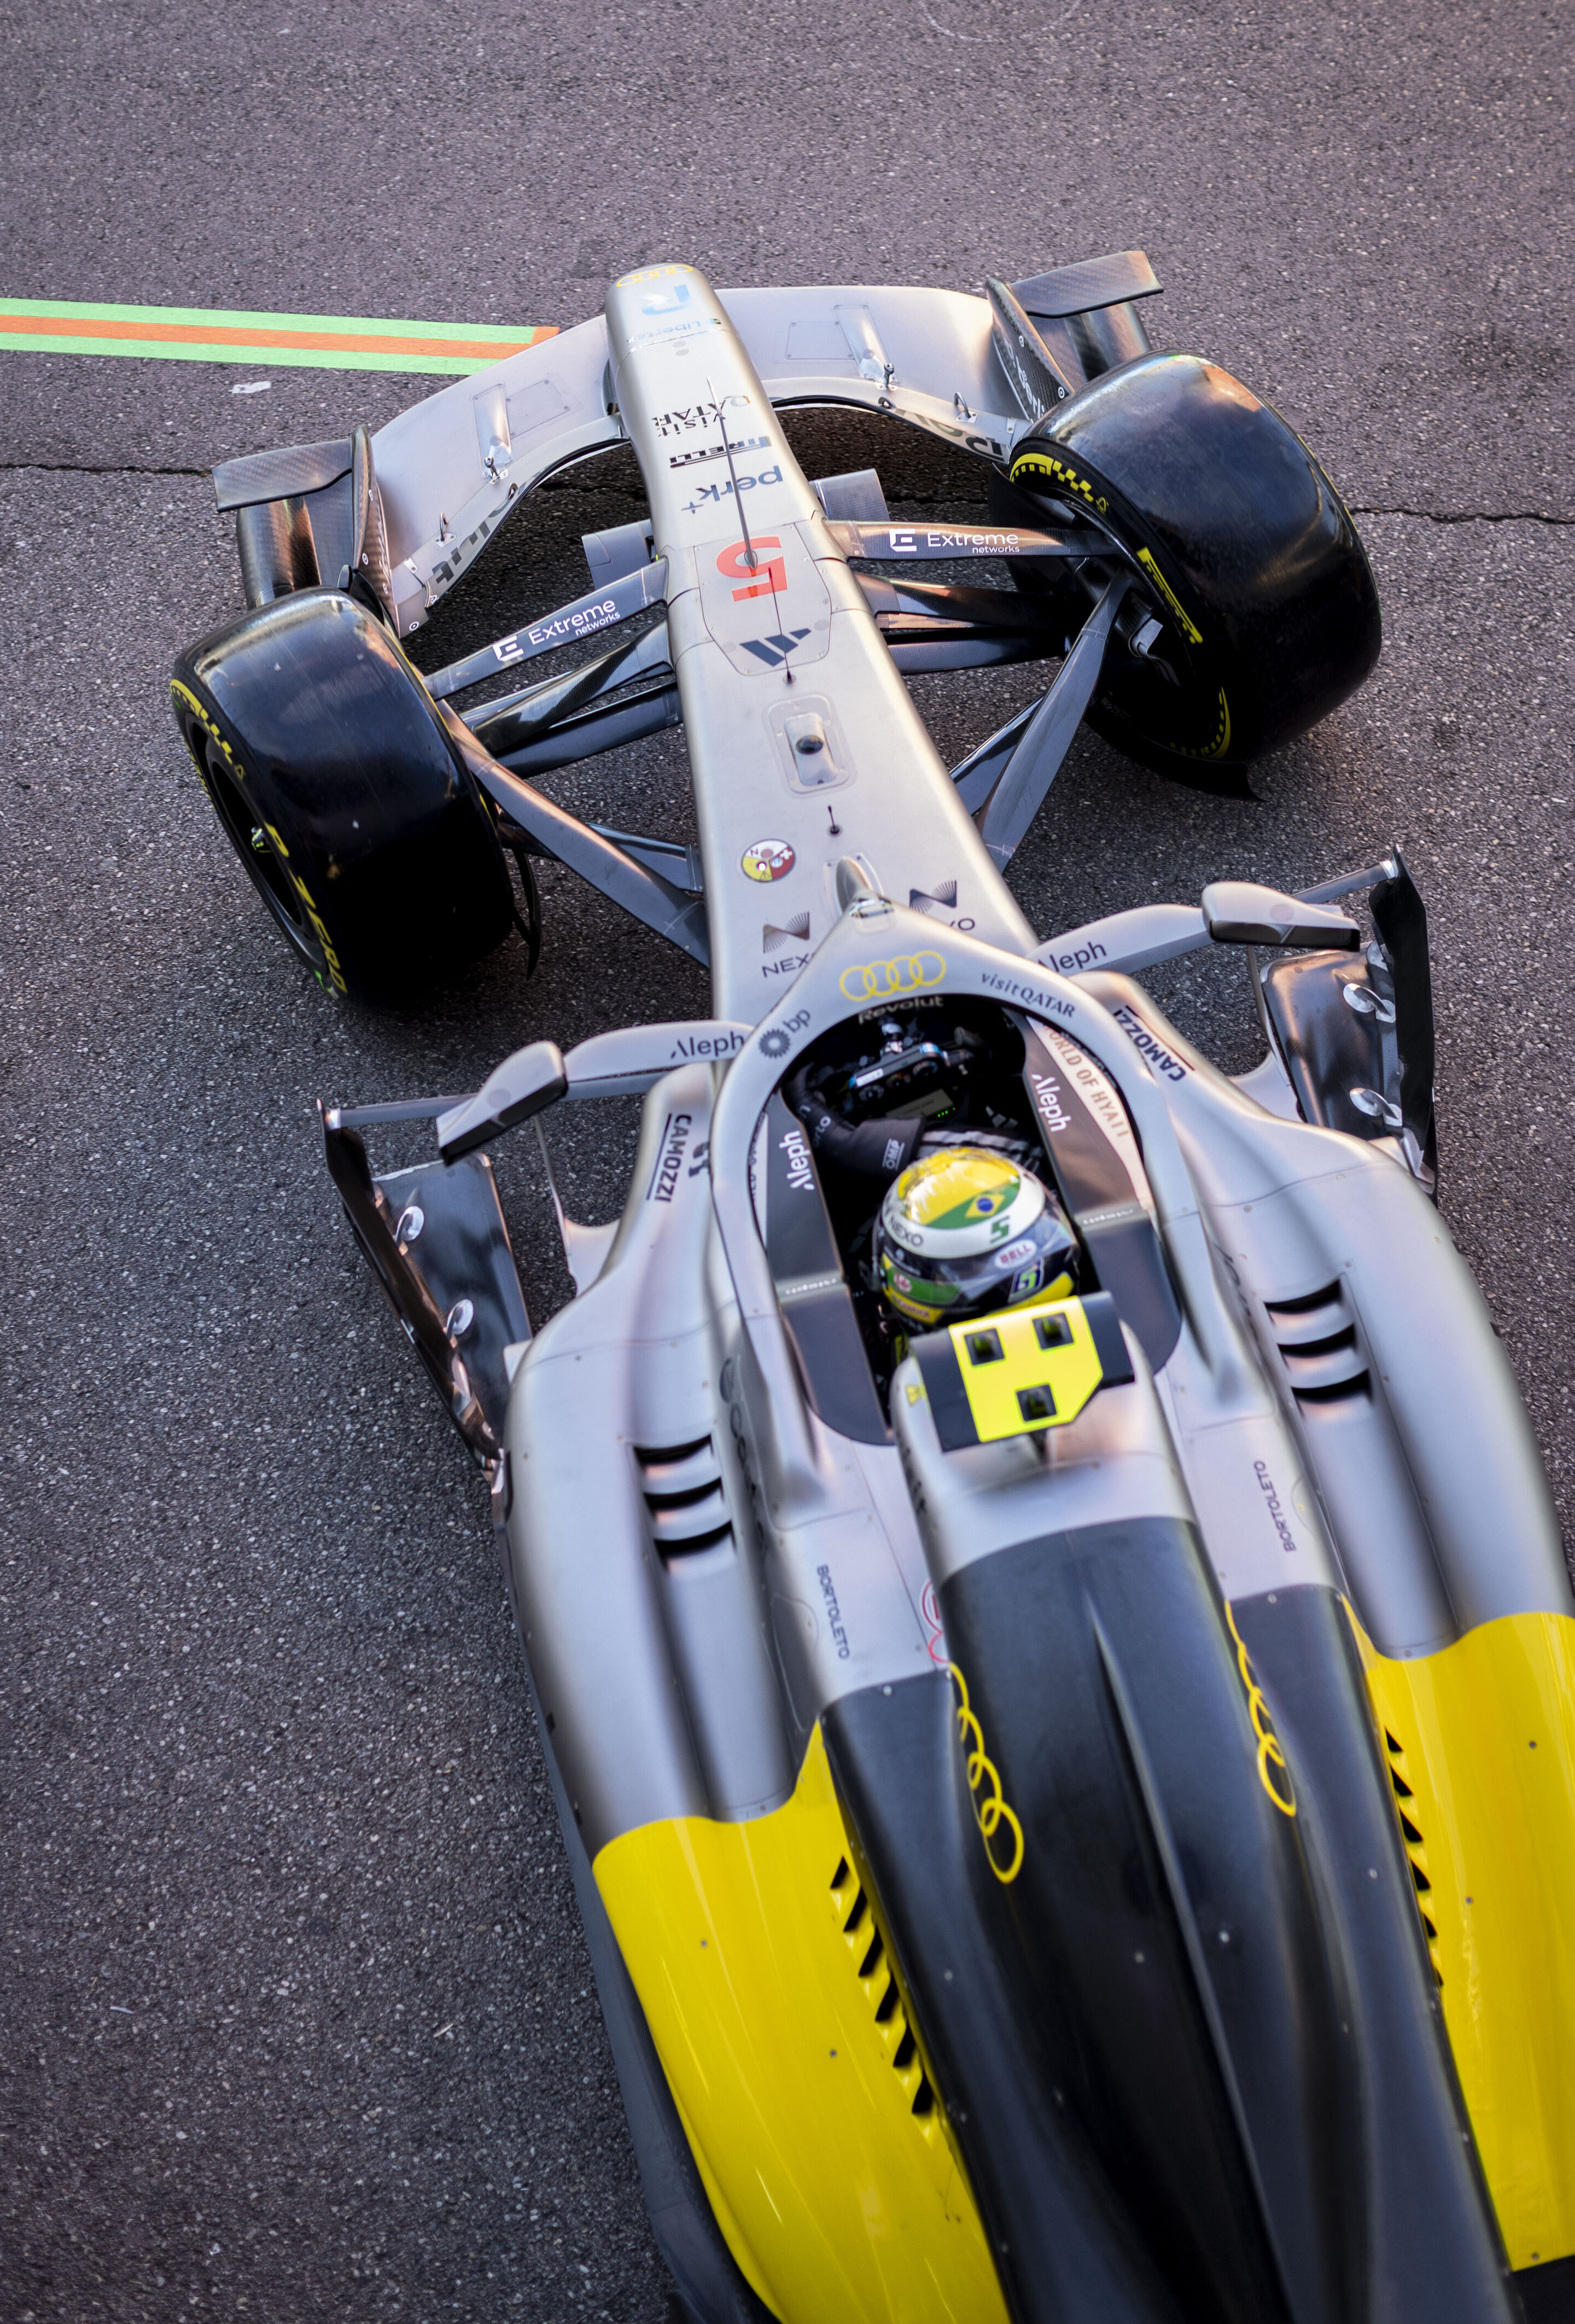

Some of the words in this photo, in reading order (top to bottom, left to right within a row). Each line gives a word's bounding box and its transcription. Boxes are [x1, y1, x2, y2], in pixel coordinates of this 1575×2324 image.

[652, 395, 751, 427] QATAR
[656, 413, 726, 437] visit
[670, 436, 772, 469] PIRELLI
[927, 532, 1019, 547] Extreme
[972, 545, 1020, 554] networks
[716, 536, 788, 602] 5
[528, 600, 616, 645] Extreme
[575, 611, 621, 637] networks
[762, 952, 815, 978] NEX
[783, 1009, 812, 1033] bp
[858, 996, 944, 1025] Revolut
[1043, 1024, 1082, 1066] ORLD
[1076, 1069, 1099, 1087] OF
[1114, 1009, 1187, 1081] CAMOZZI
[1031, 1074, 1072, 1132] Aleph
[654, 1113, 692, 1203] CAMOZZI
[779, 1130, 815, 1190] Aleph
[885, 1139, 901, 1170] OMP
[888, 1215, 924, 1248] NEXO
[989, 1215, 1011, 1245] 5
[999, 1244, 1032, 1264] BELL
[1253, 1460, 1296, 1552] BORTOLETO
[816, 1564, 850, 1660] BORTOLETO
